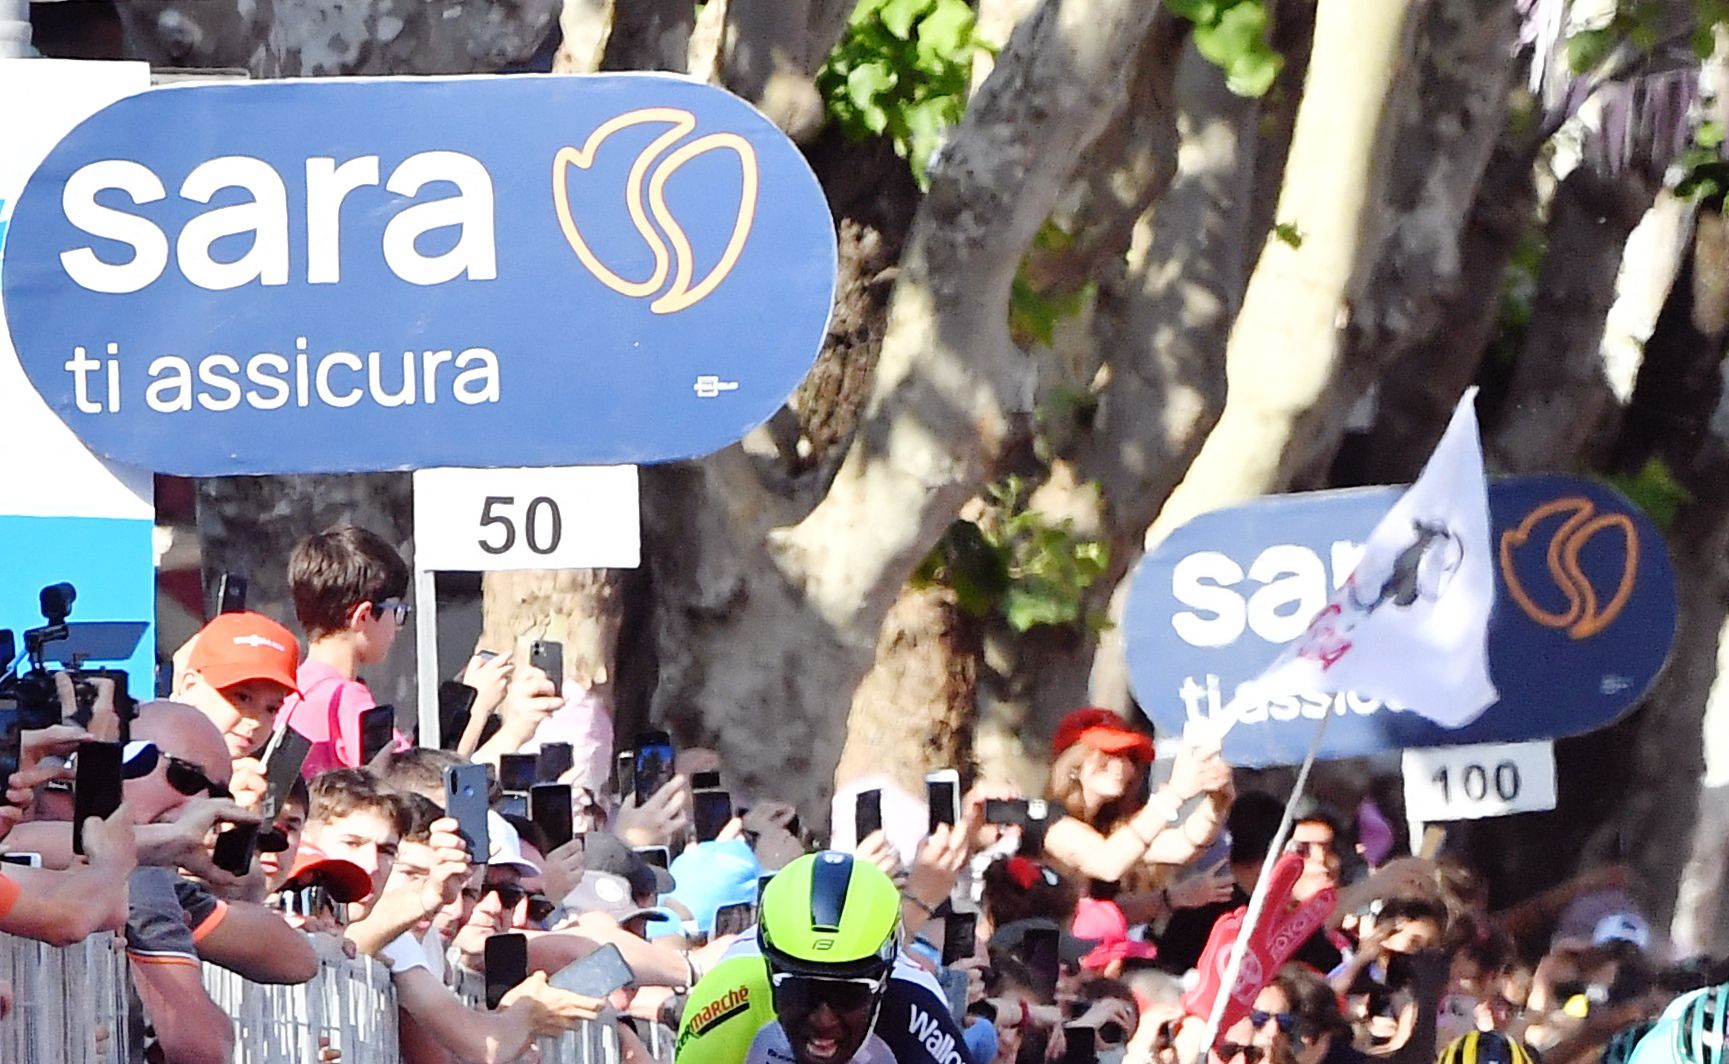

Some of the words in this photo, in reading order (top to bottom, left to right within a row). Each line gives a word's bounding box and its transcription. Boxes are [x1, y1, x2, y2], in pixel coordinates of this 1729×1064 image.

[60, 150, 498, 294] sara
[64, 342, 120, 414] ti
[146, 337, 501, 412] assicura
[477, 496, 563, 556] 50
[1171, 539, 1372, 648] sar
[1431, 760, 1521, 802] 100
